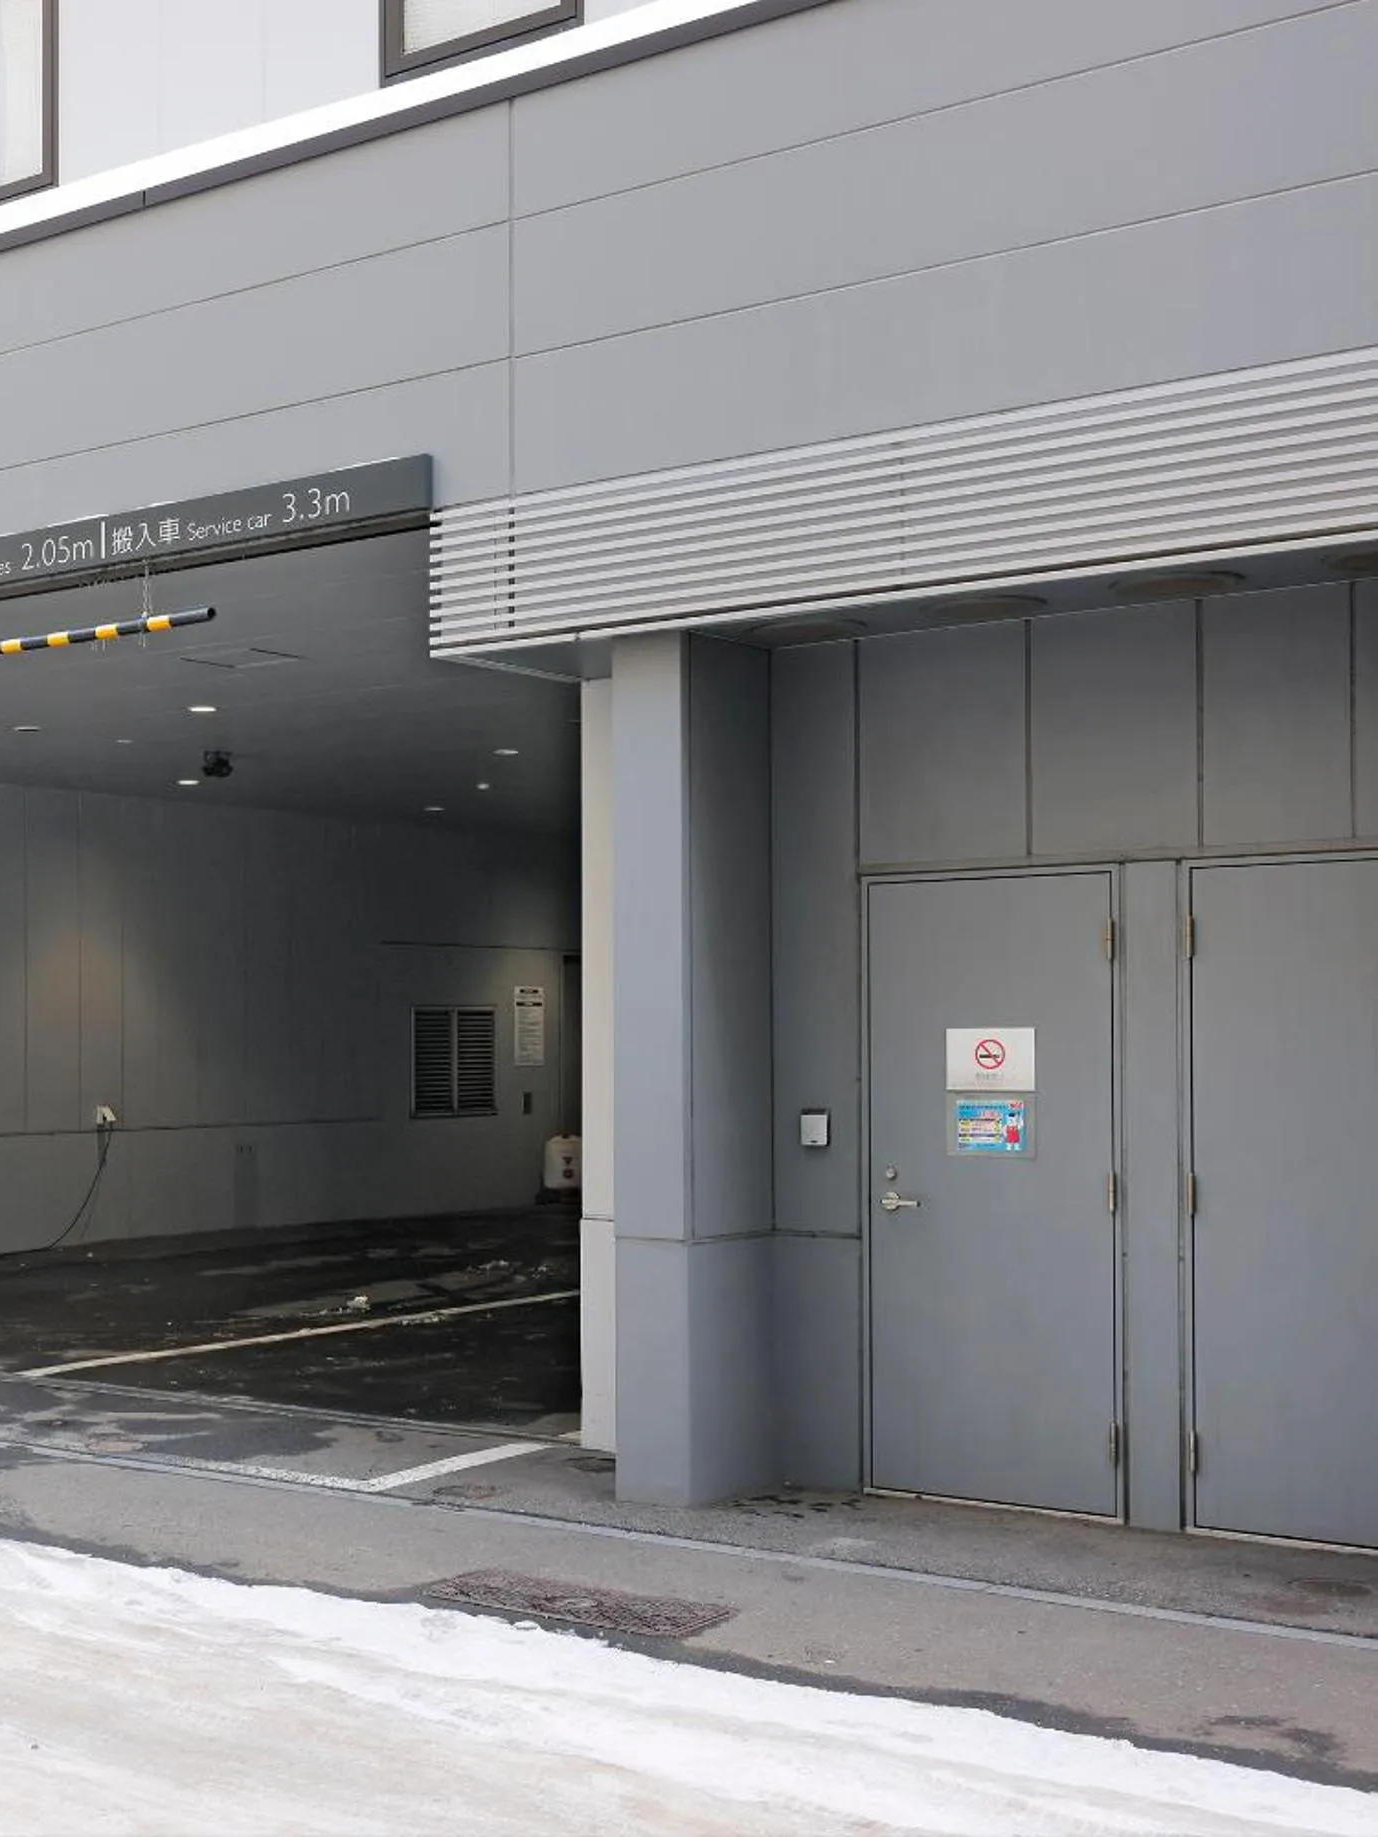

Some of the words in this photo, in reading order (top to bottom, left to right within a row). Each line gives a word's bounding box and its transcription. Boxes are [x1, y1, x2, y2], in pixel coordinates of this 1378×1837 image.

[21, 535, 95, 571] 2.05m
[111, 518, 181, 556] 搬入車
[186, 516, 242, 542] Service
[247, 512, 273, 531] car
[281, 487, 351, 524] 3.3m
